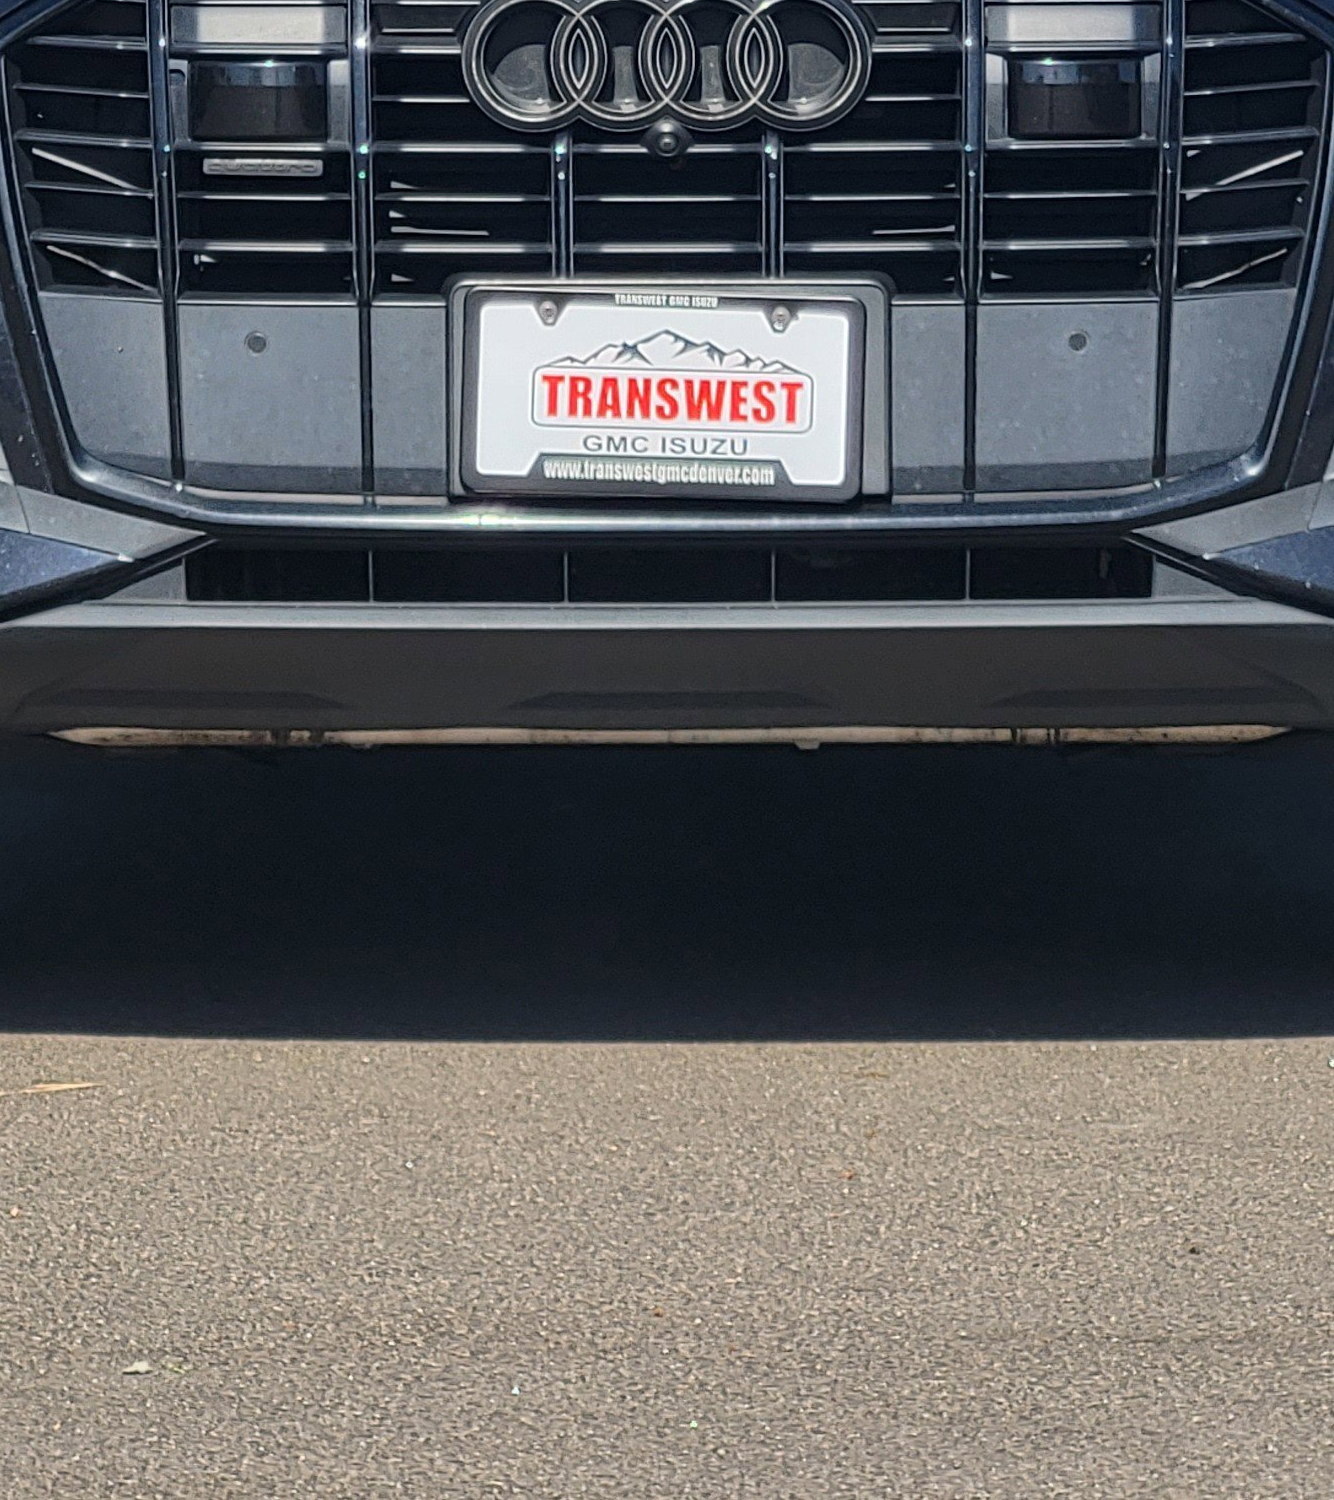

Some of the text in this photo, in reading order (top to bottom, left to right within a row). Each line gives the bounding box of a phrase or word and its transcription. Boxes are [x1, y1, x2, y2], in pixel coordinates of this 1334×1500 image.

[614, 294, 667, 307] TRANSWEST
[691, 297, 719, 308] ISUZU
[541, 375, 804, 424] TRANSWEST
[582, 435, 748, 456] GMC ISUZU
[543, 460, 775, 486] www.transwestgmcdenver.com
